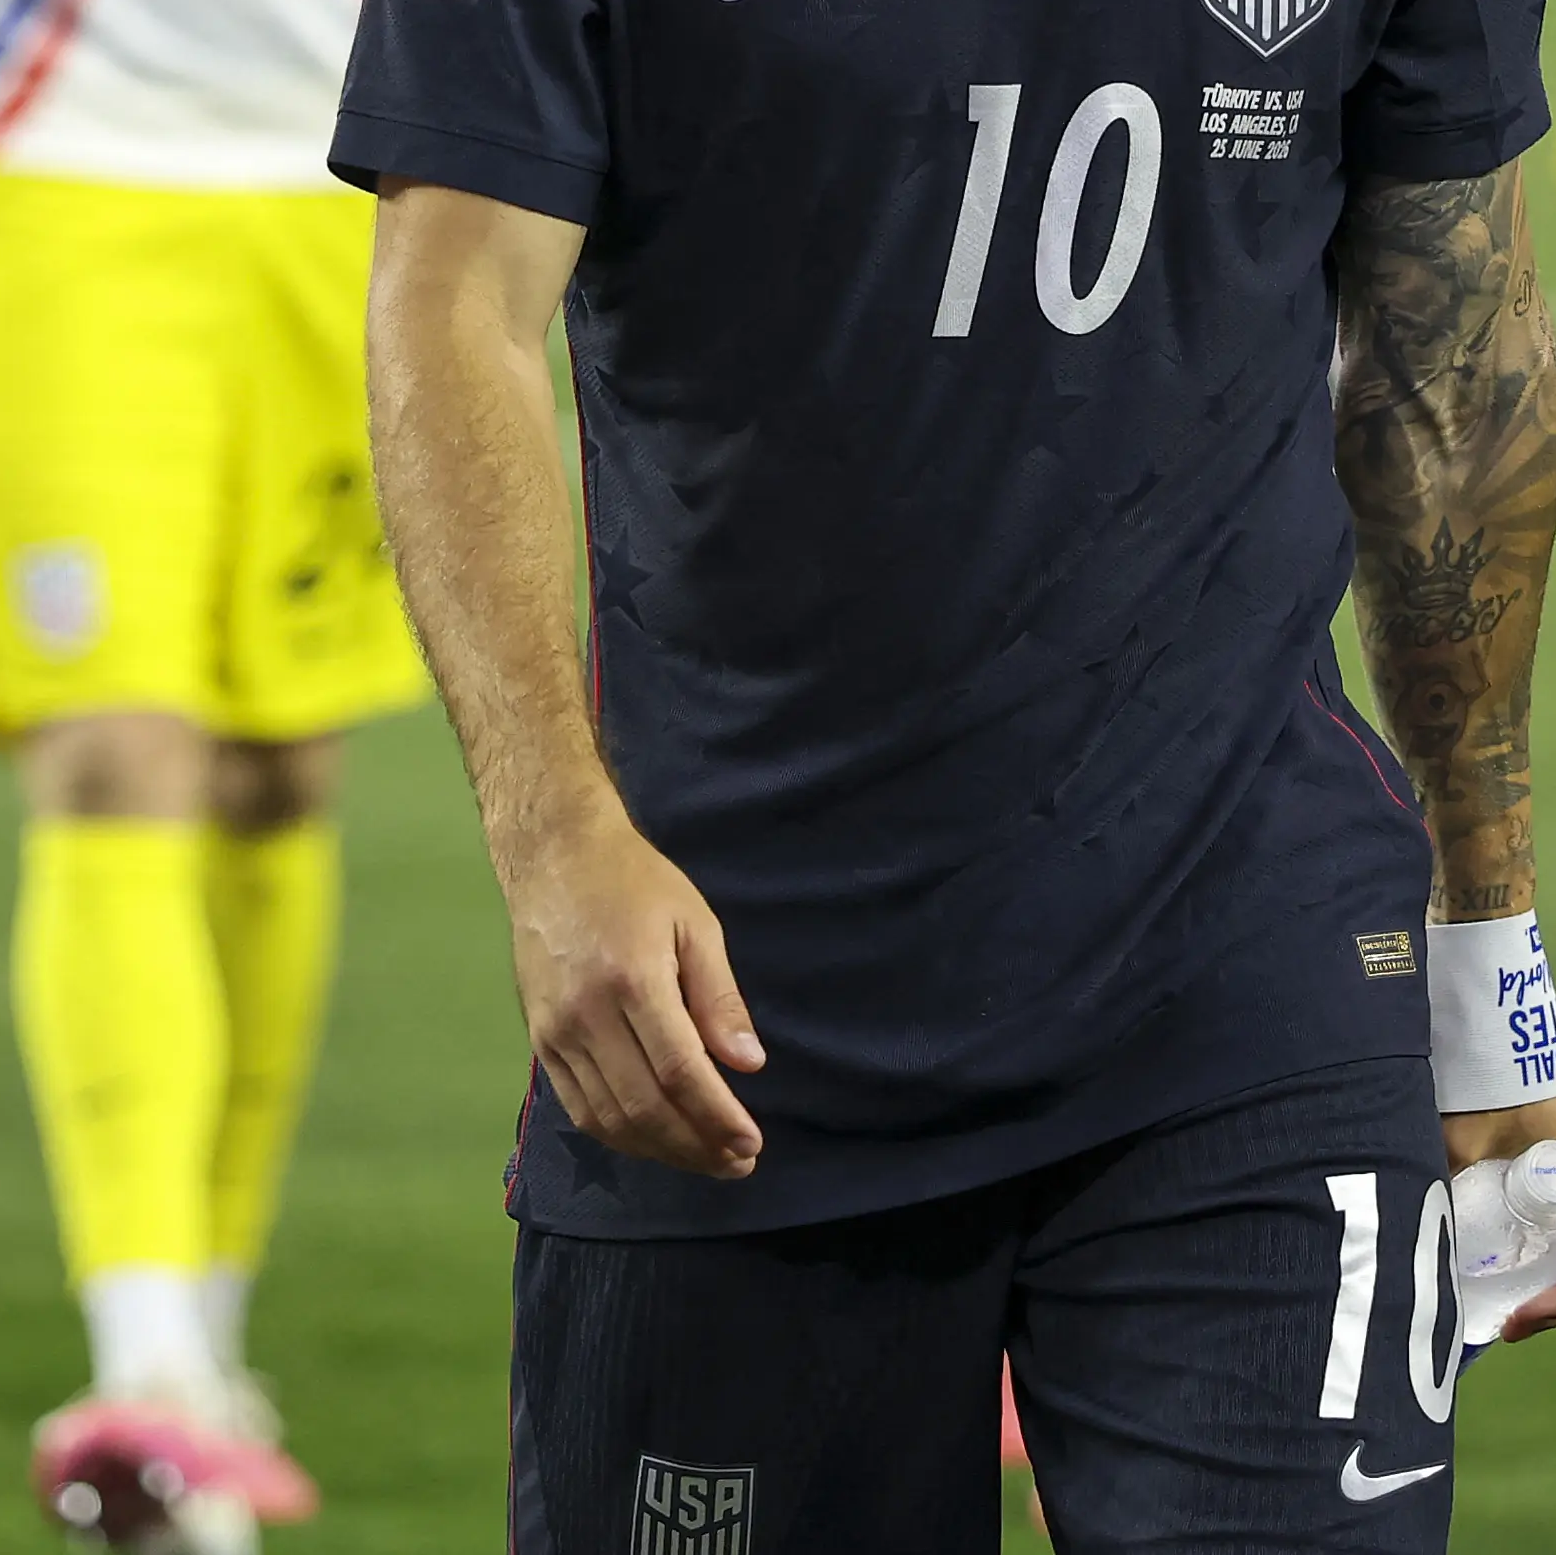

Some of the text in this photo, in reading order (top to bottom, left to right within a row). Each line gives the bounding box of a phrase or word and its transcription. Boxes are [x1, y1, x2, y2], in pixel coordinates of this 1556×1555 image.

[1264, 90, 1283, 111] VS.
[1286, 90, 1305, 111] USA
[1199, 112, 1228, 133] LOS
[1229, 115, 1286, 138] ANGELES,
[1210, 138, 1292, 160] 25 JUNE 2026
[932, 82, 1162, 336] 10
[1319, 1172, 1465, 1423] 10
[645, 1467, 743, 1530] USA
